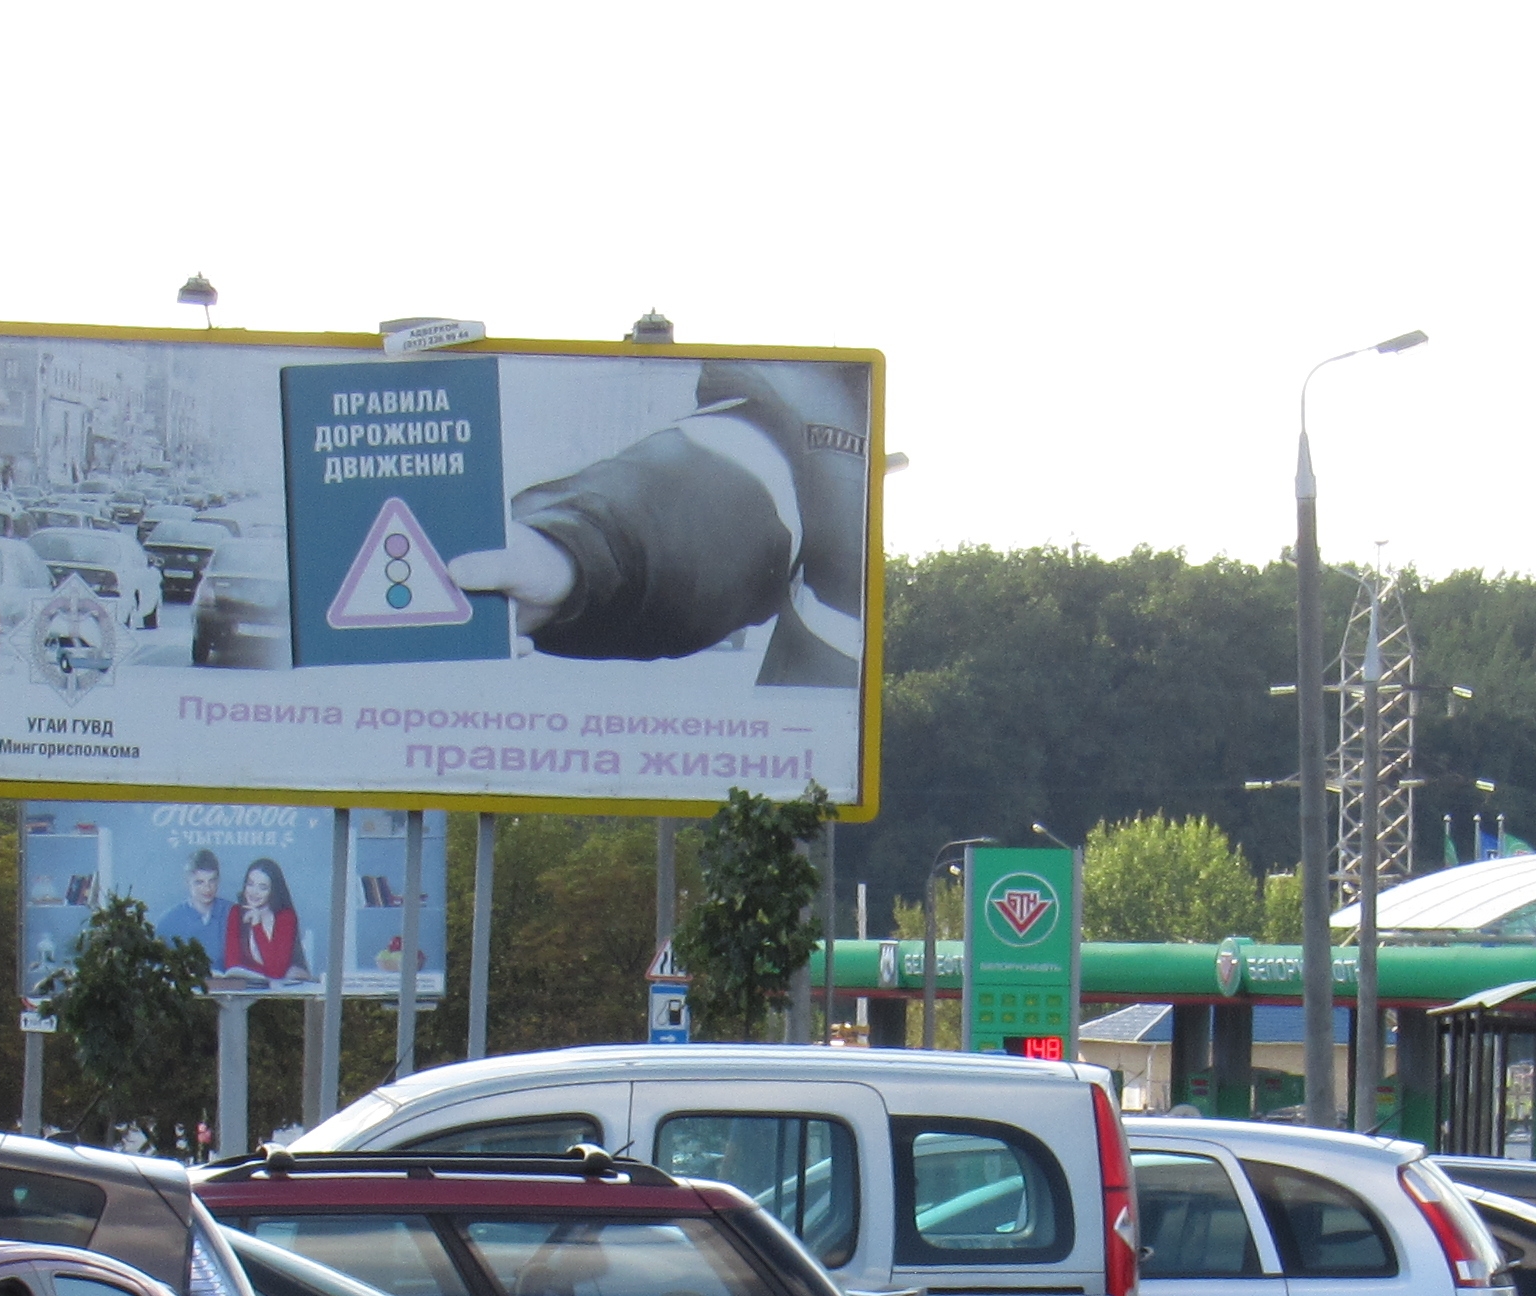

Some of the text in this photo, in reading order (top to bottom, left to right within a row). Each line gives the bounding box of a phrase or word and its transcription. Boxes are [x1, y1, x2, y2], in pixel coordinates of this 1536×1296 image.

[332, 388, 450, 416] ПРАВИЛА
[314, 419, 471, 452] ДОРОЖНОГО
[324, 452, 465, 484] ДВИЖЕНИЯ
[27, 717, 114, 737] УГАИ ГУВД
[178, 695, 343, 726] Правила
[355, 707, 568, 733] дорожного
[580, 714, 770, 738] движения
[405, 744, 815, 780] правила жизни!
